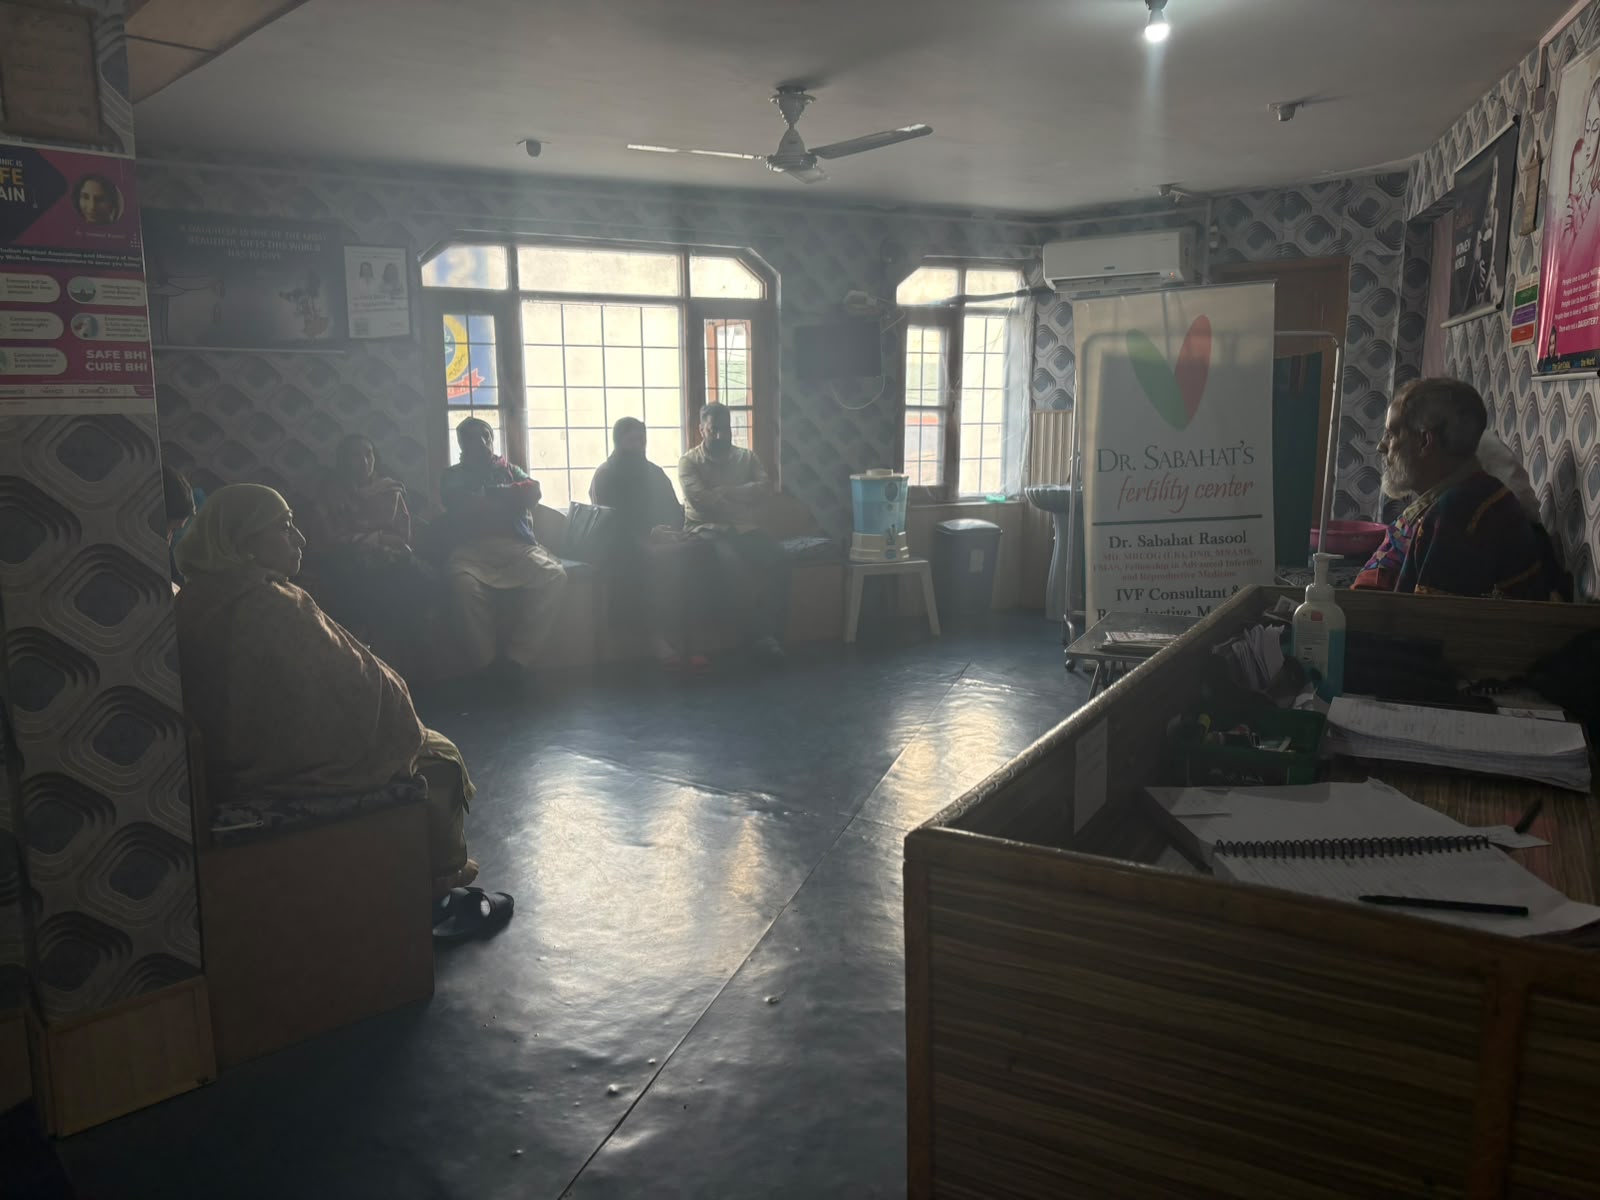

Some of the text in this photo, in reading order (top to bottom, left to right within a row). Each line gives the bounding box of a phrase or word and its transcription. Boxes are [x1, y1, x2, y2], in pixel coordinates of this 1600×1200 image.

[86, 349, 147, 361] SAFE BHI
[85, 362, 148, 373] CURE BHI
[1117, 472, 1254, 514] fertility center
[1108, 529, 1247, 549] Dr. Sabahat Rasool
[1124, 561, 1169, 572] Fellowship
[1182, 559, 1224, 569] Advanced
[1122, 573, 1138, 582] and
[1140, 571, 1196, 583] Reproductive
[1116, 584, 1241, 602] IVF Consultant &
